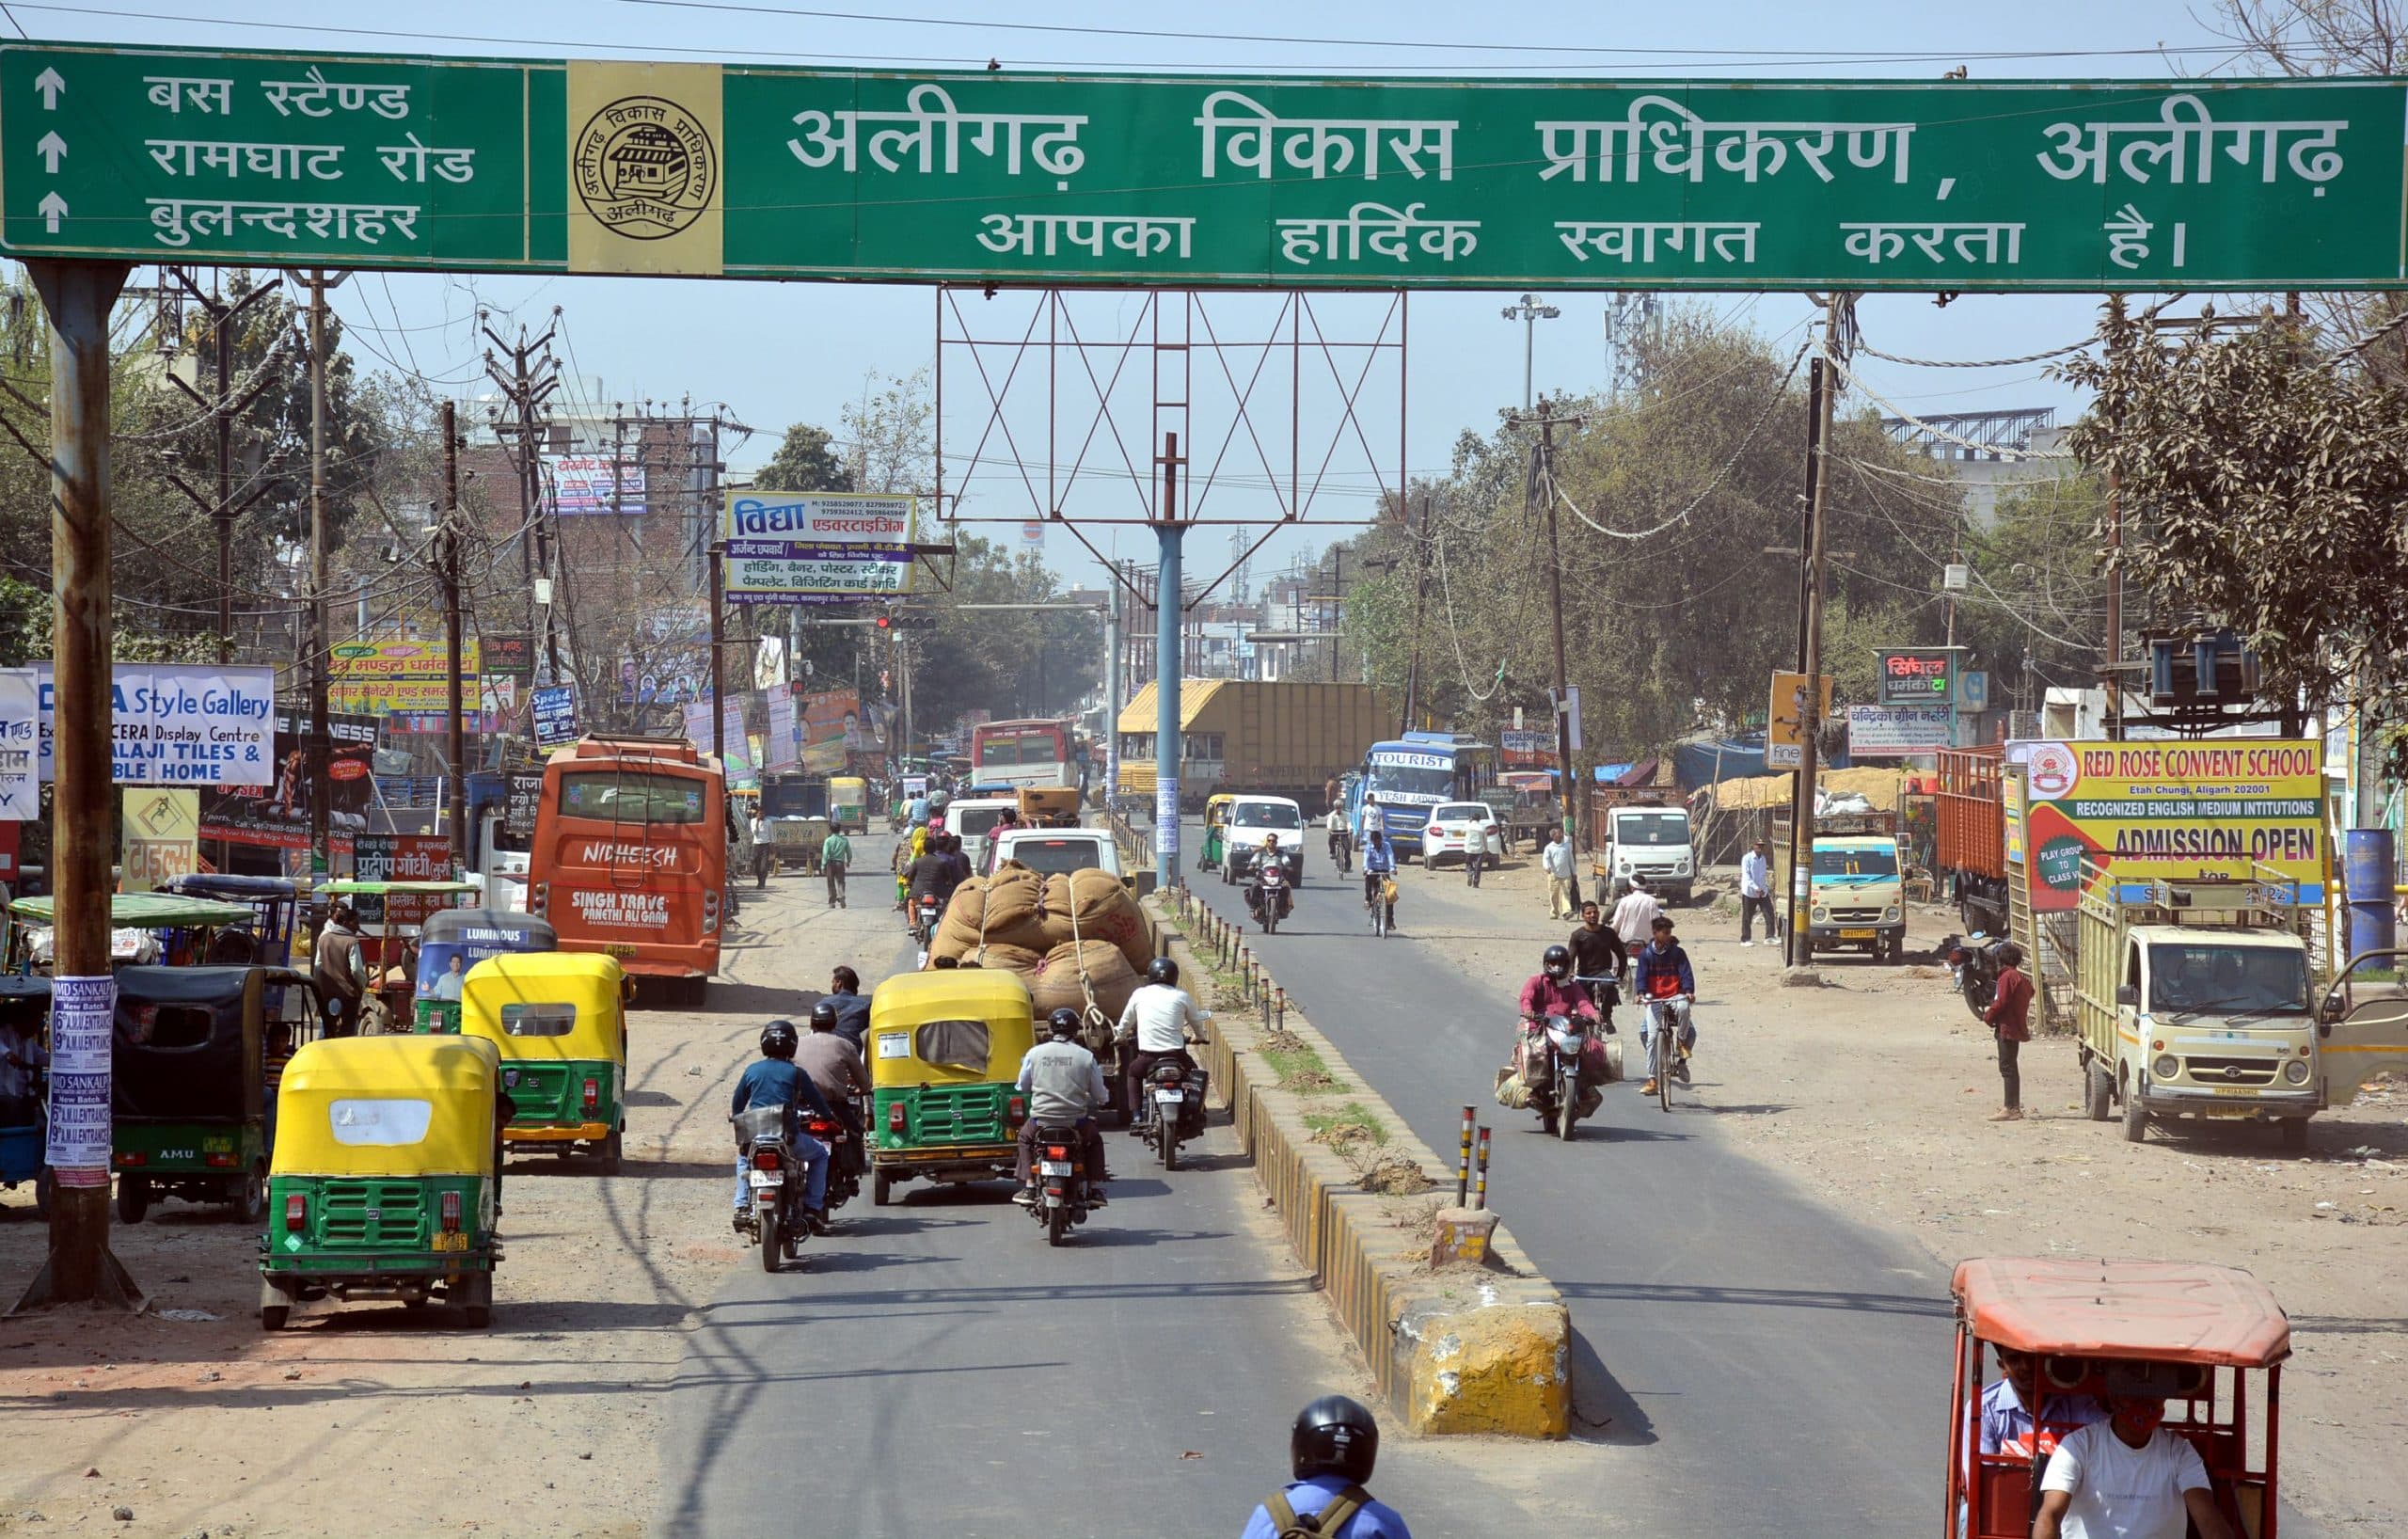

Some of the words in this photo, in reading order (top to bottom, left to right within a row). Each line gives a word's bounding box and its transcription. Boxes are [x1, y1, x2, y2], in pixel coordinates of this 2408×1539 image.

[144, 75, 233, 115] बस
[261, 65, 411, 120] स्टैण्ड
[786, 83, 1088, 191] अलीगढ़
[1194, 90, 1460, 182] विकास
[2036, 94, 2350, 198] अलीगढ़
[145, 138, 345, 182] रामघाट
[376, 132, 475, 183] रोड
[578, 129, 608, 196] अलीगढ़
[605, 104, 668, 129] विकास
[673, 118, 707, 201] प्राधिकरण
[606, 198, 677, 226] अलीगढ़
[146, 198, 420, 247] बुलन्दशहर
[975, 213, 1196, 260] आपका
[1275, 201, 1481, 266] हार्दिक
[1554, 221, 1761, 265] स्वागत
[1839, 221, 2027, 265] करता
[2103, 202, 2186, 268] है।
[734, 499, 805, 536] विद्या
[812, 516, 905, 534] एडवरटाइजिंग
[843, 577, 868, 590] कार्ड
[870, 578, 898, 590] आदि
[135, 689, 198, 719] Style
[202, 689, 270, 720] Gallery
[532, 689, 571, 706] Speed
[1894, 706, 1918, 723] ग्रीन
[155, 724, 201, 743] Display
[210, 725, 261, 743] Centre
[1504, 733, 1536, 742] ENGLISH
[173, 743, 235, 760] TILES
[245, 744, 261, 762] &
[1375, 753, 1447, 767] TOURIST
[1774, 745, 1800, 758] fine
[162, 763, 221, 780] HOME
[2083, 750, 2115, 778] RED
[2118, 750, 2162, 778] ROSE
[2165, 749, 2243, 778] CONVENT
[2247, 748, 2317, 777] SCHOOL
[1378, 791, 1407, 802] YESH
[2130, 785, 2153, 795] Etah
[2155, 785, 2193, 796] Chungi,
[2195, 785, 2232, 796] Aligarh
[2234, 785, 2271, 794] 202001
[2077, 801, 2146, 817] RECOGNIZED
[2147, 801, 2194, 817] ENGLISH
[2197, 801, 2242, 817] MEDIUM
[2243, 801, 2315, 816] INTITUTIONS
[2115, 827, 2243, 862] ADMISSION
[2252, 827, 2315, 861] OPEN
[582, 840, 678, 867] NIDHEESH
[2040, 848, 2059, 861] PLAY
[356, 851, 396, 876] प्रदीप
[397, 851, 430, 877] गाँधी
[2058, 860, 2069, 869] TO
[2048, 873, 2071, 884] CLASS
[572, 891, 616, 909] SINGH
[582, 908, 623, 921] PANETHI
[625, 909, 640, 922] ALI
[641, 911, 669, 924] GARH
[467, 928, 521, 942] LUMINOUS
[55, 982, 71, 997] MD
[63, 1002, 81, 1010] New
[83, 1002, 104, 1010] Batch
[53, 1075, 66, 1089] MD
[67, 1074, 108, 1089] SANKALP
[160, 1150, 195, 1159] AMU
